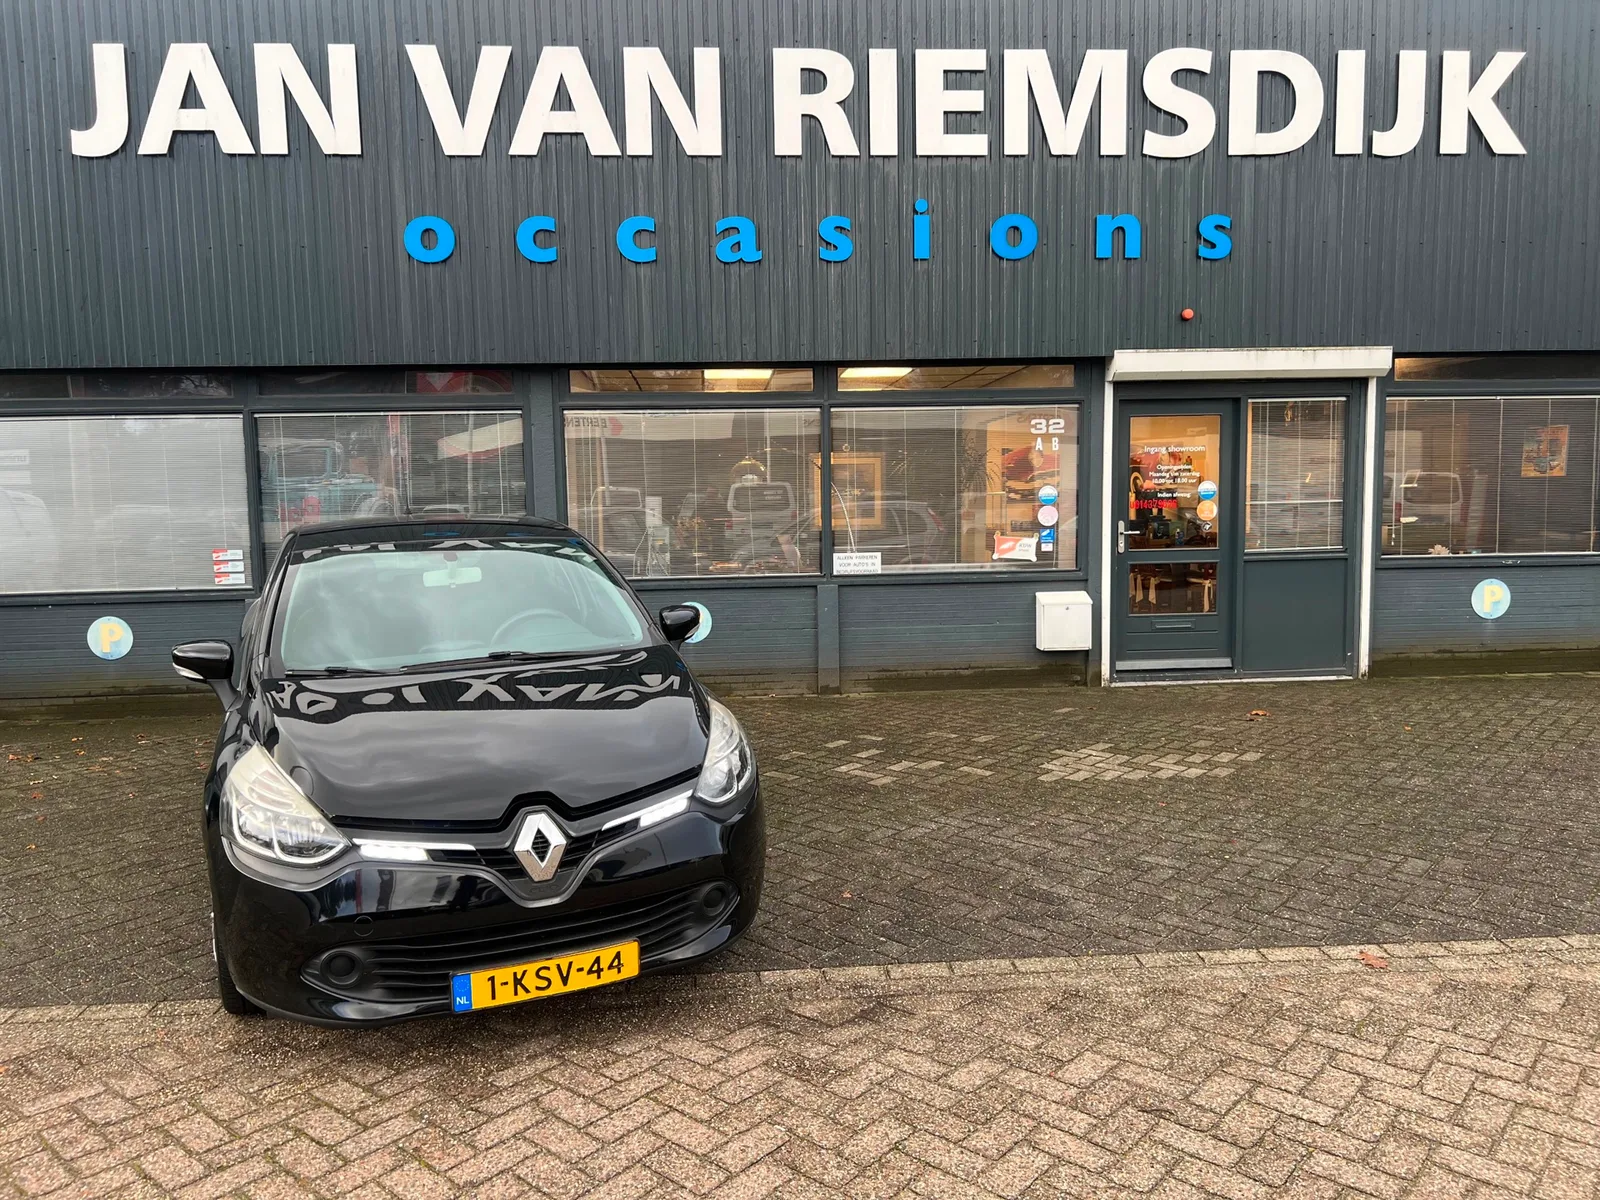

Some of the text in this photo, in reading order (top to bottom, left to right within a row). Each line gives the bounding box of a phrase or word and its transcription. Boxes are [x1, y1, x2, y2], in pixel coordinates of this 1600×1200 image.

[70, 42, 1528, 158] JAN VAN RIEMSDIJK
[403, 199, 1233, 263] occasions
[1030, 418, 1065, 434] 32
[1035, 437, 1059, 451] A B
[1144, 446, 1167, 454] Ingang
[1483, 585, 1504, 613] P
[101, 623, 124, 653] P
[487, 950, 625, 1001] 1-KSV-44
[456, 997, 470, 1005] NL
